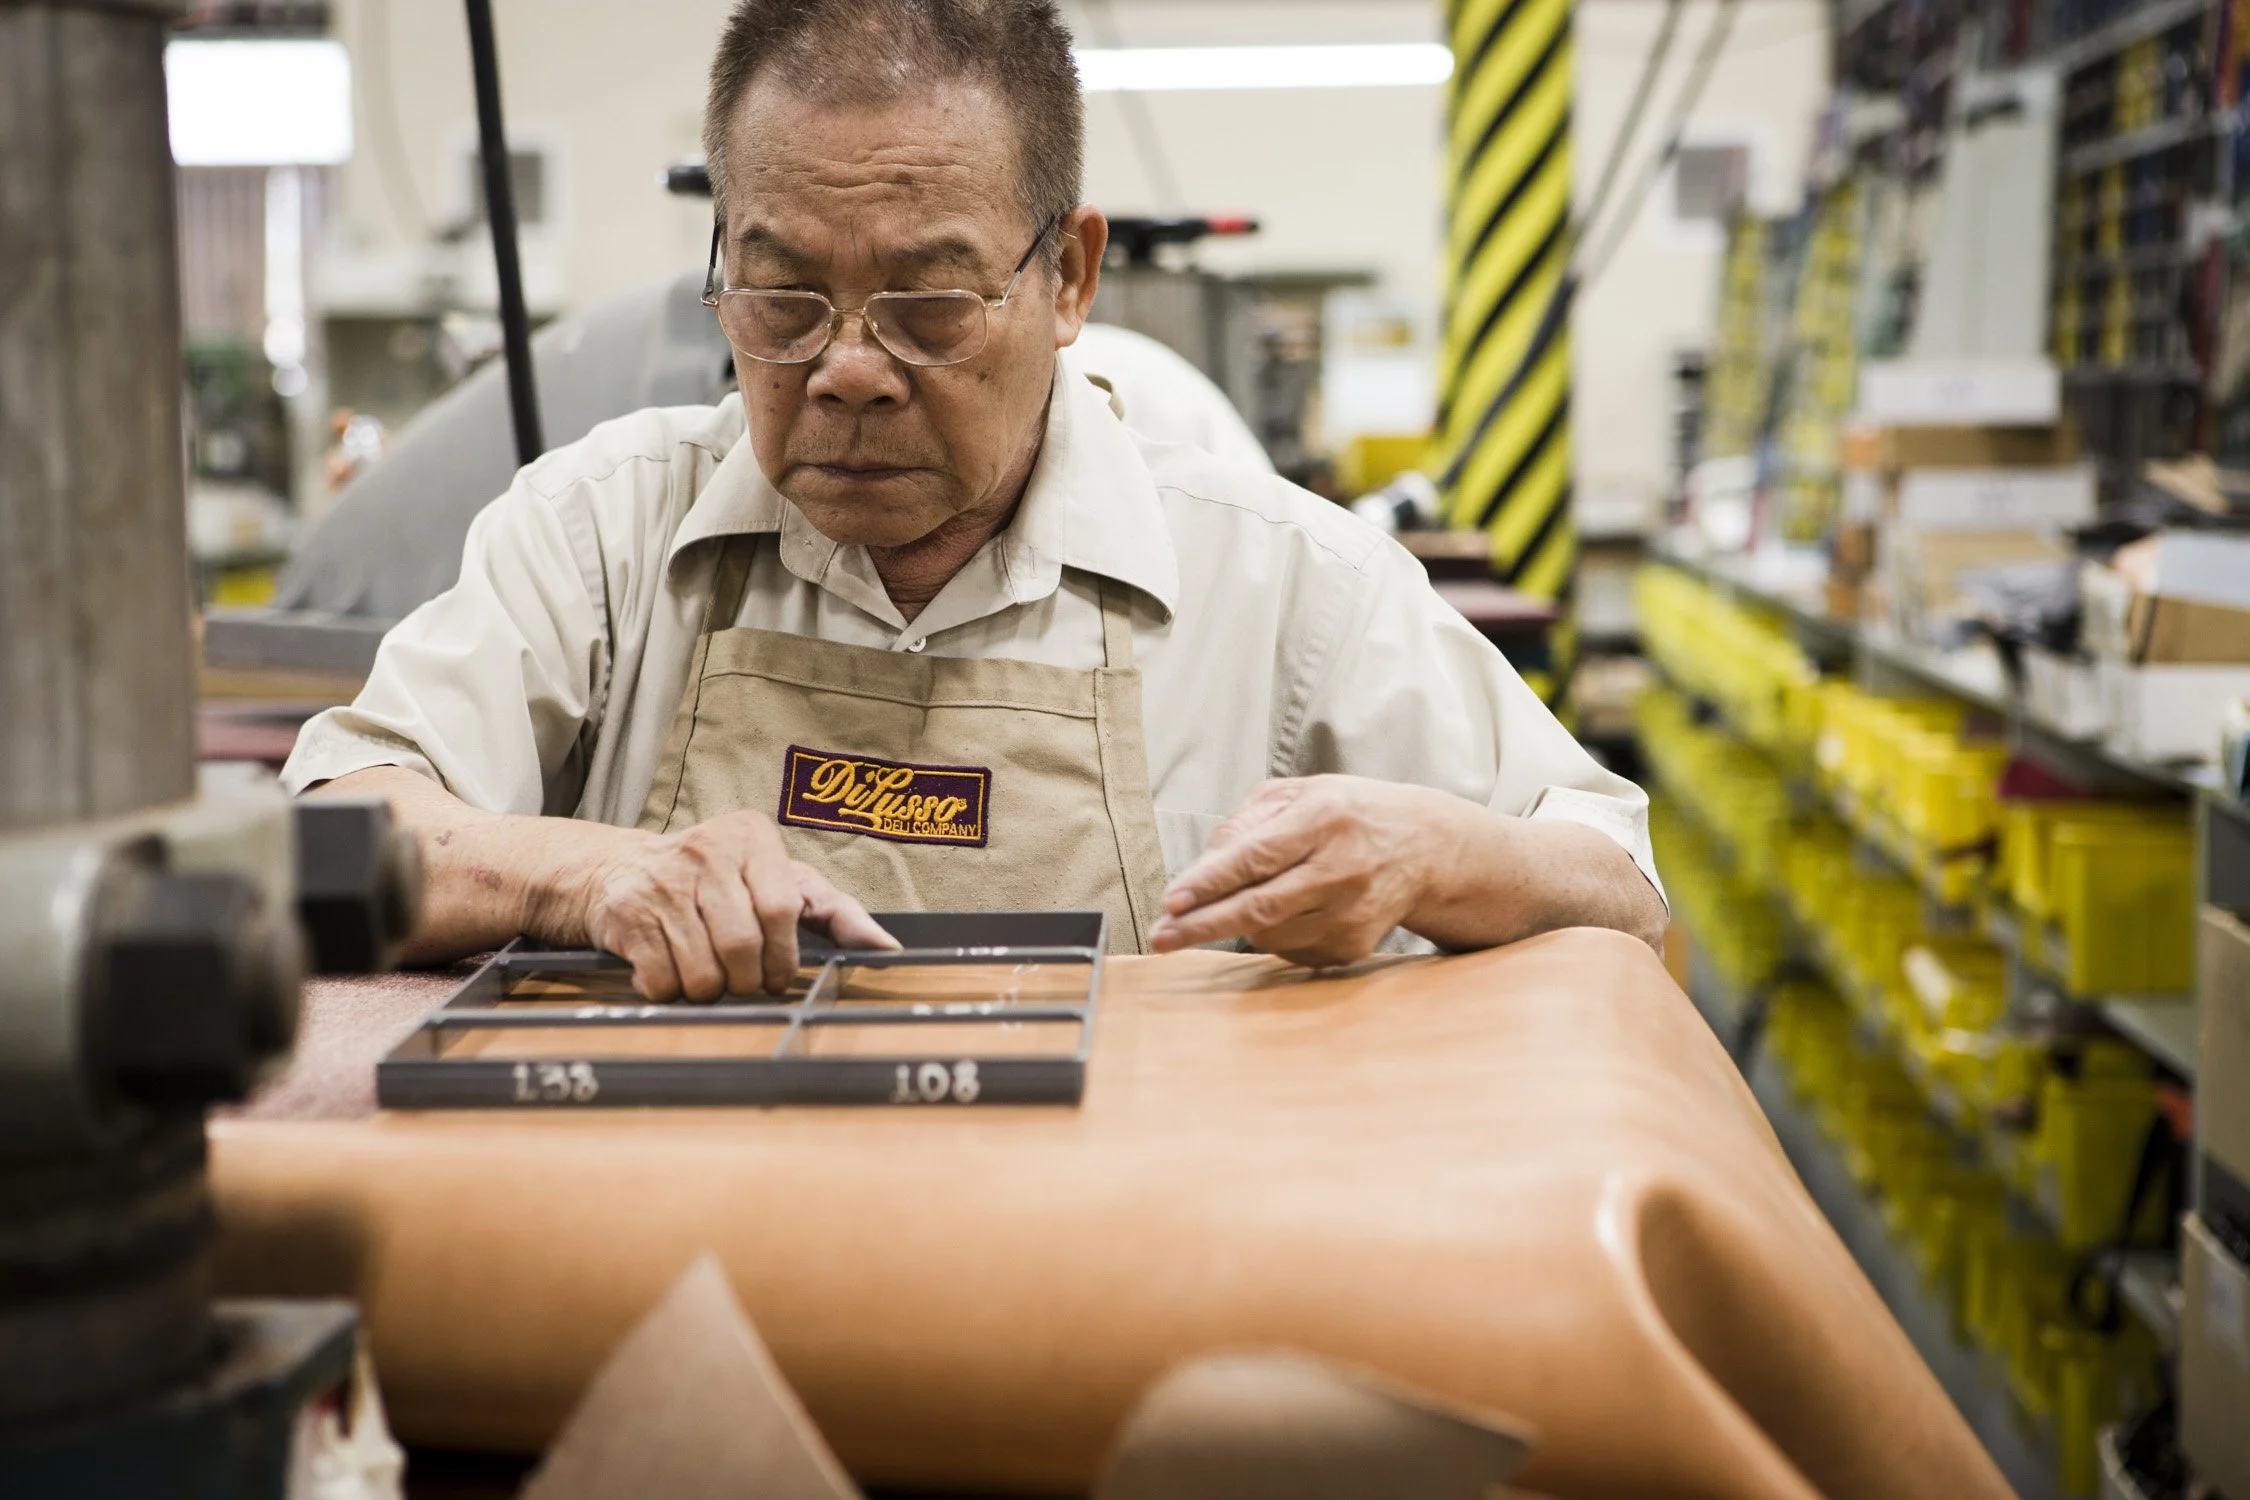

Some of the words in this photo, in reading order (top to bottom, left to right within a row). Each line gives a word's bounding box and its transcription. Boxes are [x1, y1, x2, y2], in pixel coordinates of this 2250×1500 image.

[883, 818, 911, 833] DELI
[912, 820, 978, 837] COMPANY
[889, 1059, 981, 1103] 108
